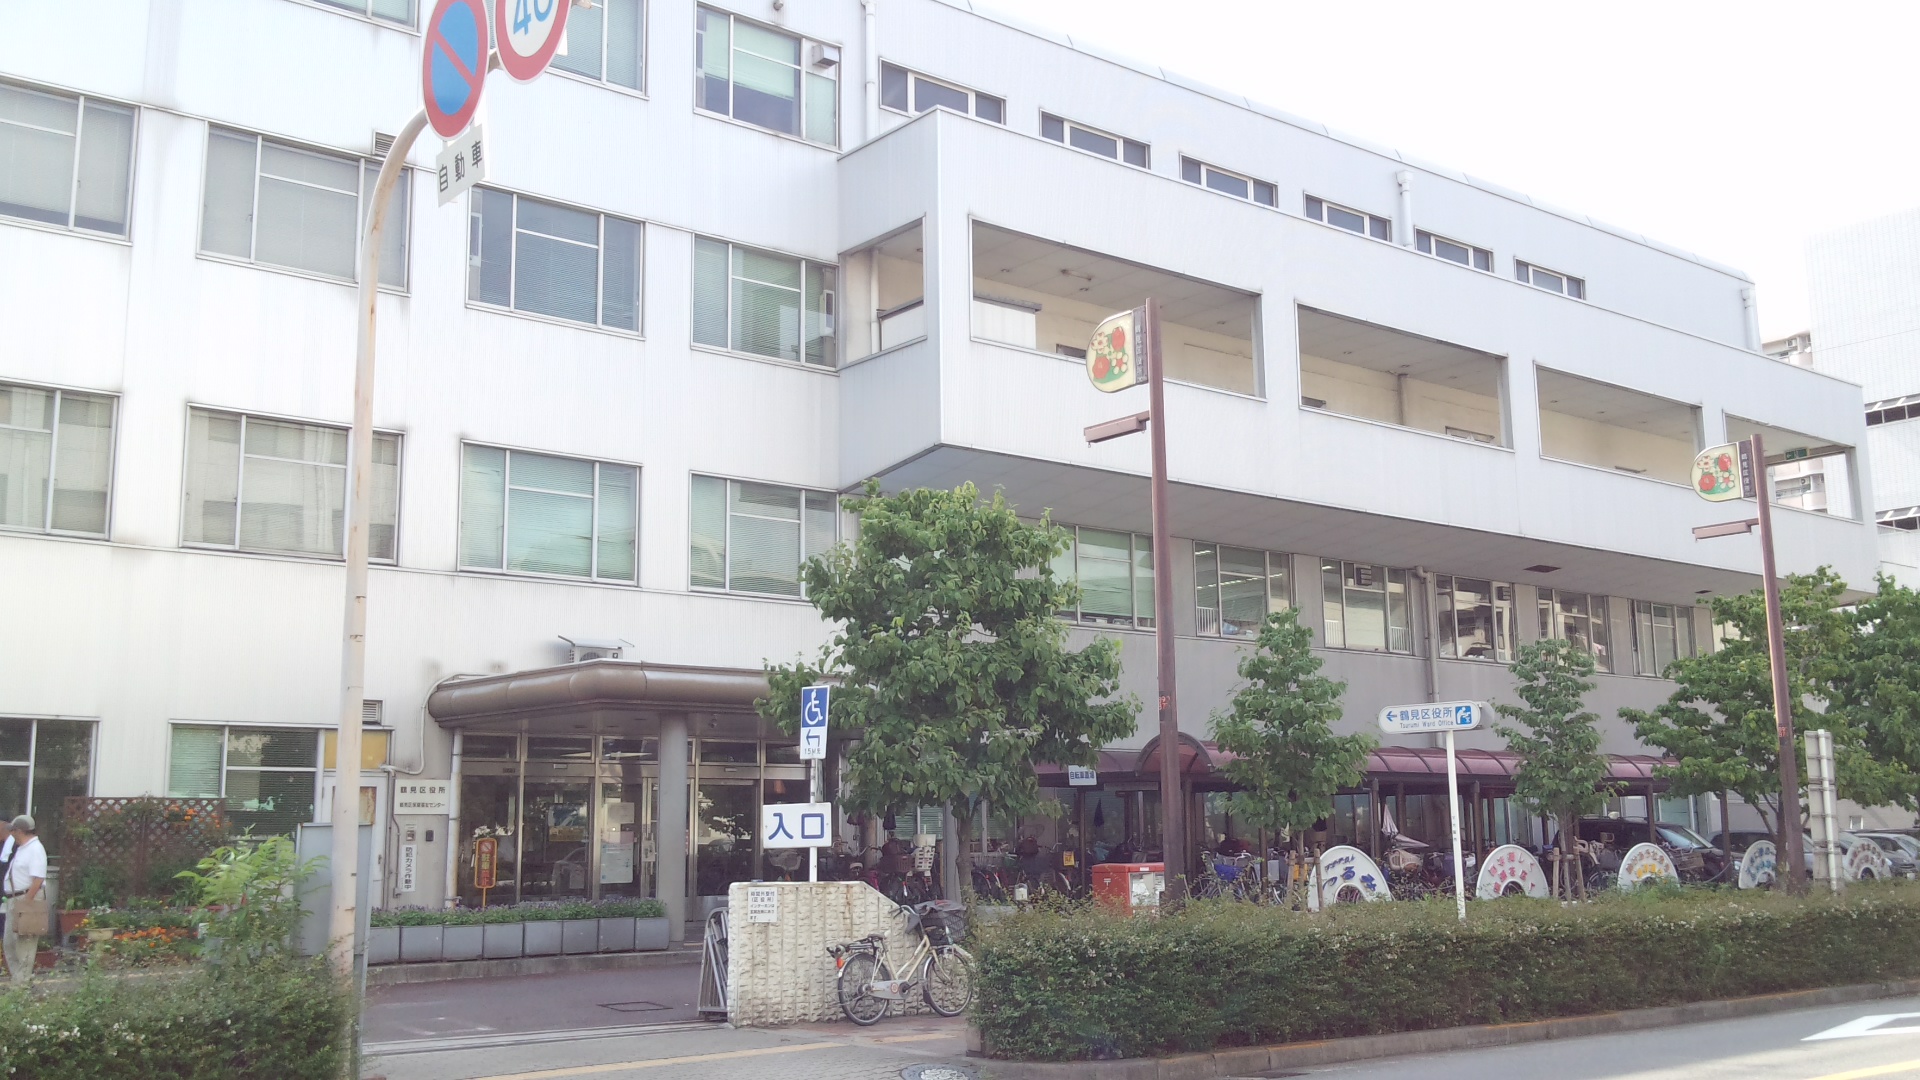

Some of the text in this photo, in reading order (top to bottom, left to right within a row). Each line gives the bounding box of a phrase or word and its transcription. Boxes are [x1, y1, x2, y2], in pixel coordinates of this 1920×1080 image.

[438, 140, 482, 193] 自動車
[1399, 706, 1453, 721] 鶴見区役所
[1400, 719, 1454, 729] Tsurumi Ward Office
[400, 786, 446, 794] 鶴見区役所
[768, 812, 825, 841] 入口
